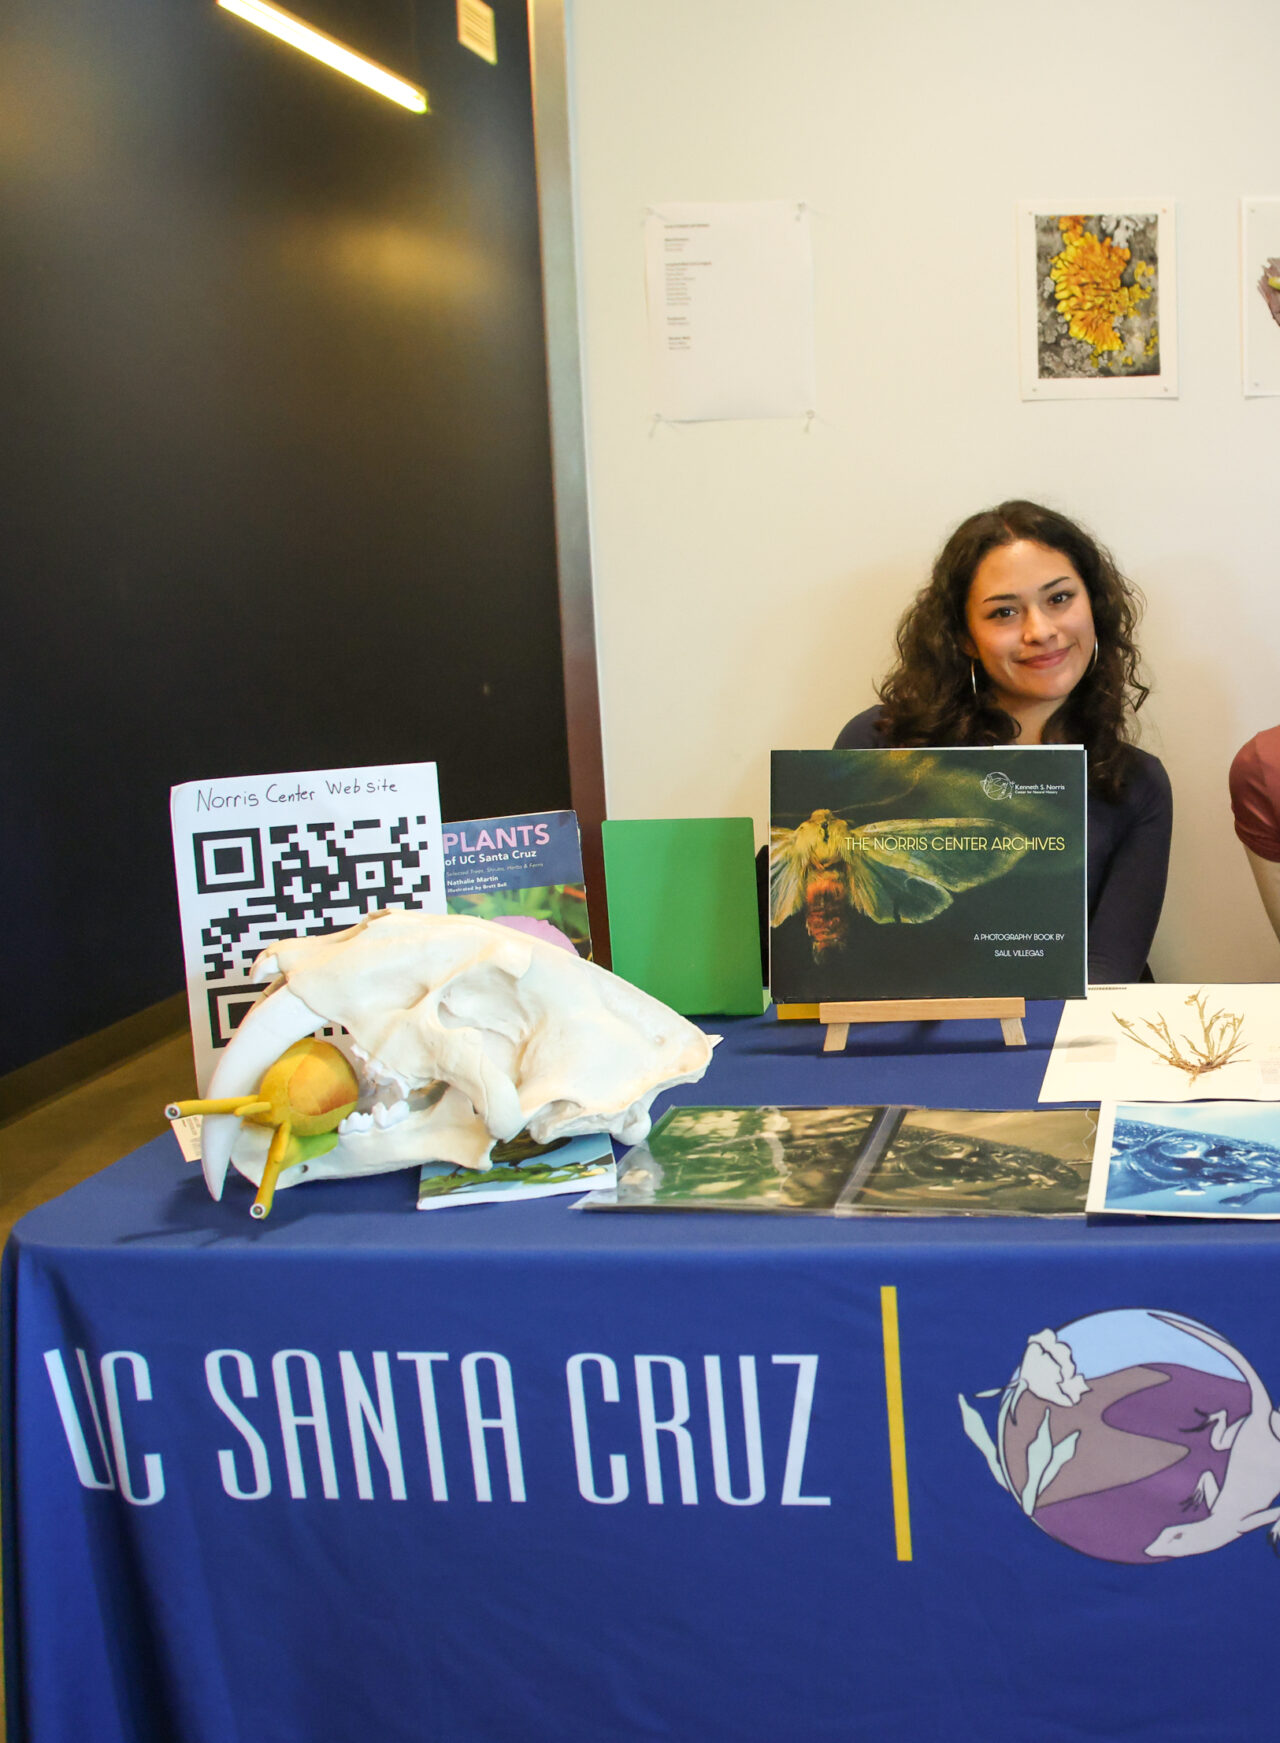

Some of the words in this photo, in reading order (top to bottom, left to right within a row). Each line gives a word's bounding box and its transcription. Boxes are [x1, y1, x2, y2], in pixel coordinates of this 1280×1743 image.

[197, 788, 259, 812] Norris
[265, 783, 315, 803] Center
[442, 823, 551, 854] PLANTS
[844, 837, 870, 850] THE
[874, 837, 928, 850] NORRIS
[931, 837, 988, 850] CENTER
[991, 837, 1065, 850] ARCHIVES
[445, 857, 456, 866] of
[460, 855, 475, 865] UC
[479, 852, 509, 863] Santa
[512, 850, 537, 859] Cruz
[973, 933, 980, 941] A
[981, 933, 1032, 941] PHOTOGRAPHY
[1033, 933, 1054, 941] BOOK
[1055, 933, 1064, 941] BY
[43, 1348, 166, 1506] UC
[203, 1348, 526, 1502] SANTA
[566, 1353, 832, 1506] CRUZ
